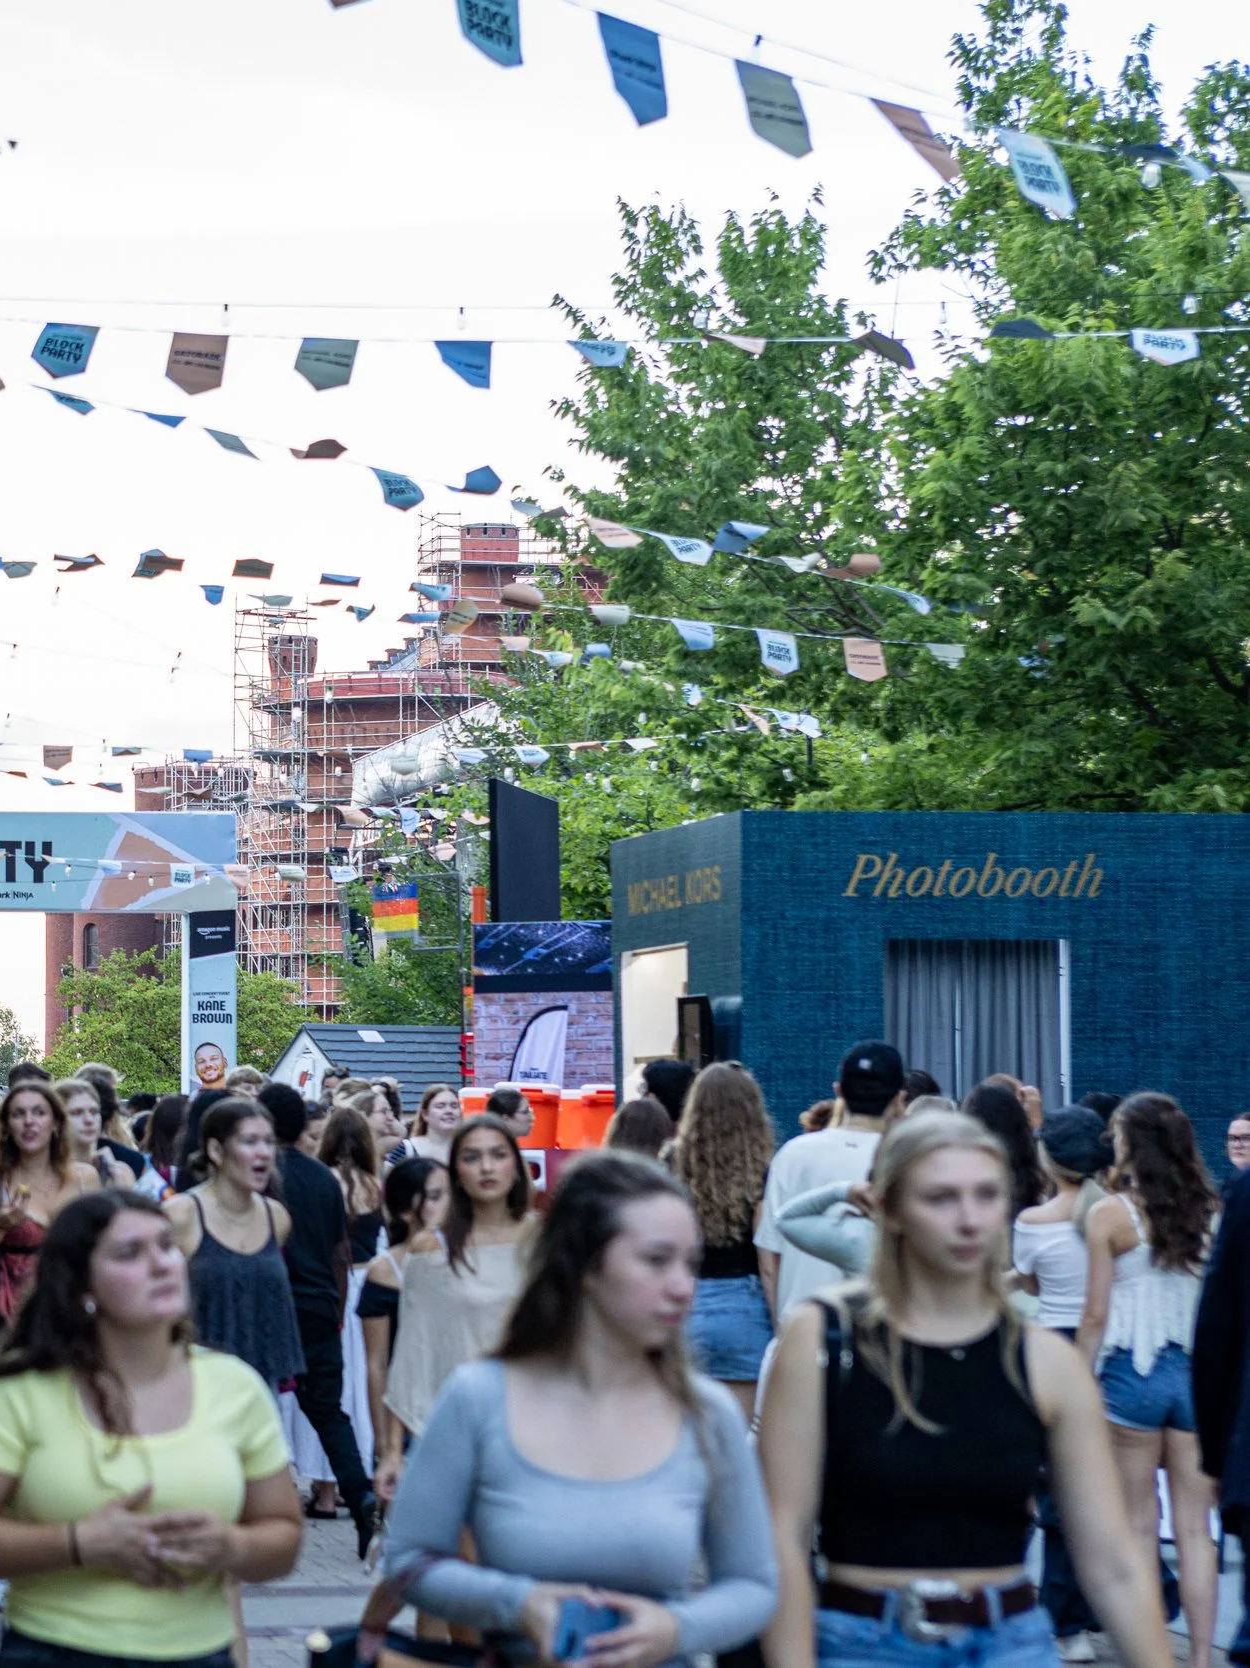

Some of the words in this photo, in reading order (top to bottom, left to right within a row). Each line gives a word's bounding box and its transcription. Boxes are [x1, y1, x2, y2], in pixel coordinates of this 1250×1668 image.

[44, 338, 86, 353] BLOCK
[40, 346, 82, 364] PARTY
[841, 852, 1104, 898] Photobooth
[628, 874, 681, 916] MICHAEL
[686, 865, 722, 904] KORS
[197, 1000, 226, 1011] KANE
[192, 1013, 232, 1024] BROWN
